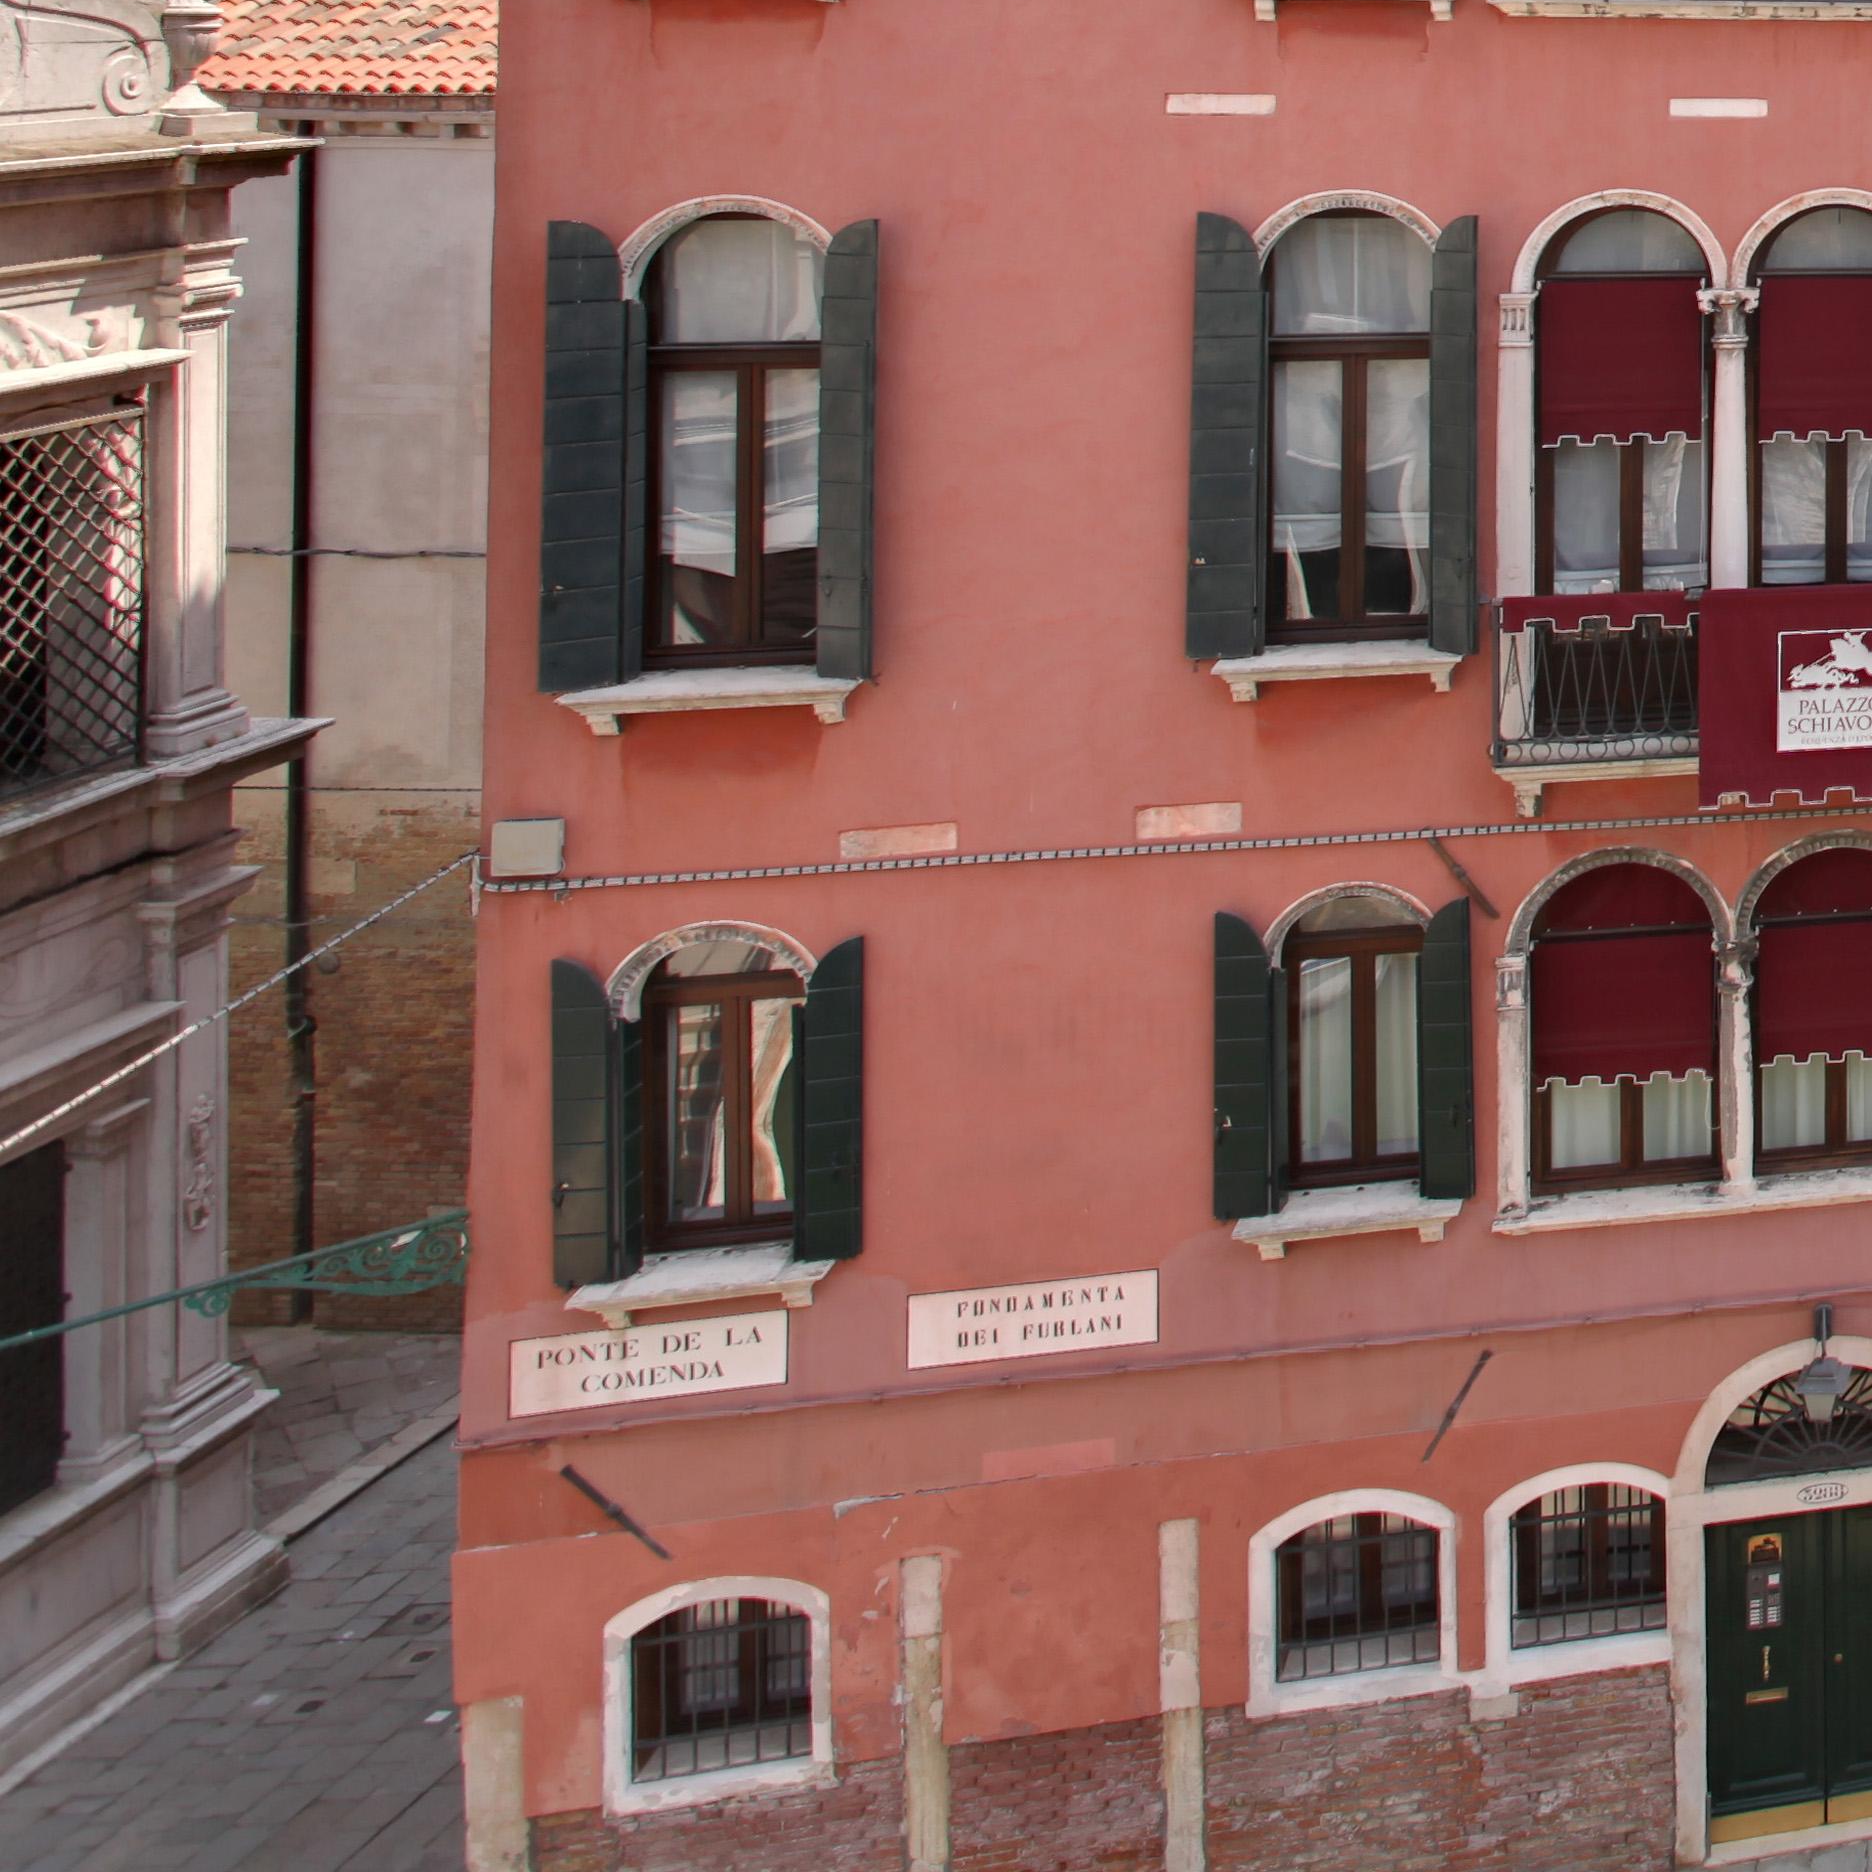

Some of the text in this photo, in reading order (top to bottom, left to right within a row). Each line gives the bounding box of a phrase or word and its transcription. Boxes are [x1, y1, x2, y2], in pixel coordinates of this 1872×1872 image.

[957, 1285, 1126, 1318] FONDAMENTA
[537, 1326, 763, 1369] PONTE DE LA
[957, 1314, 1124, 1348] DEI FURLANI
[581, 1360, 726, 1393] COMENDA
